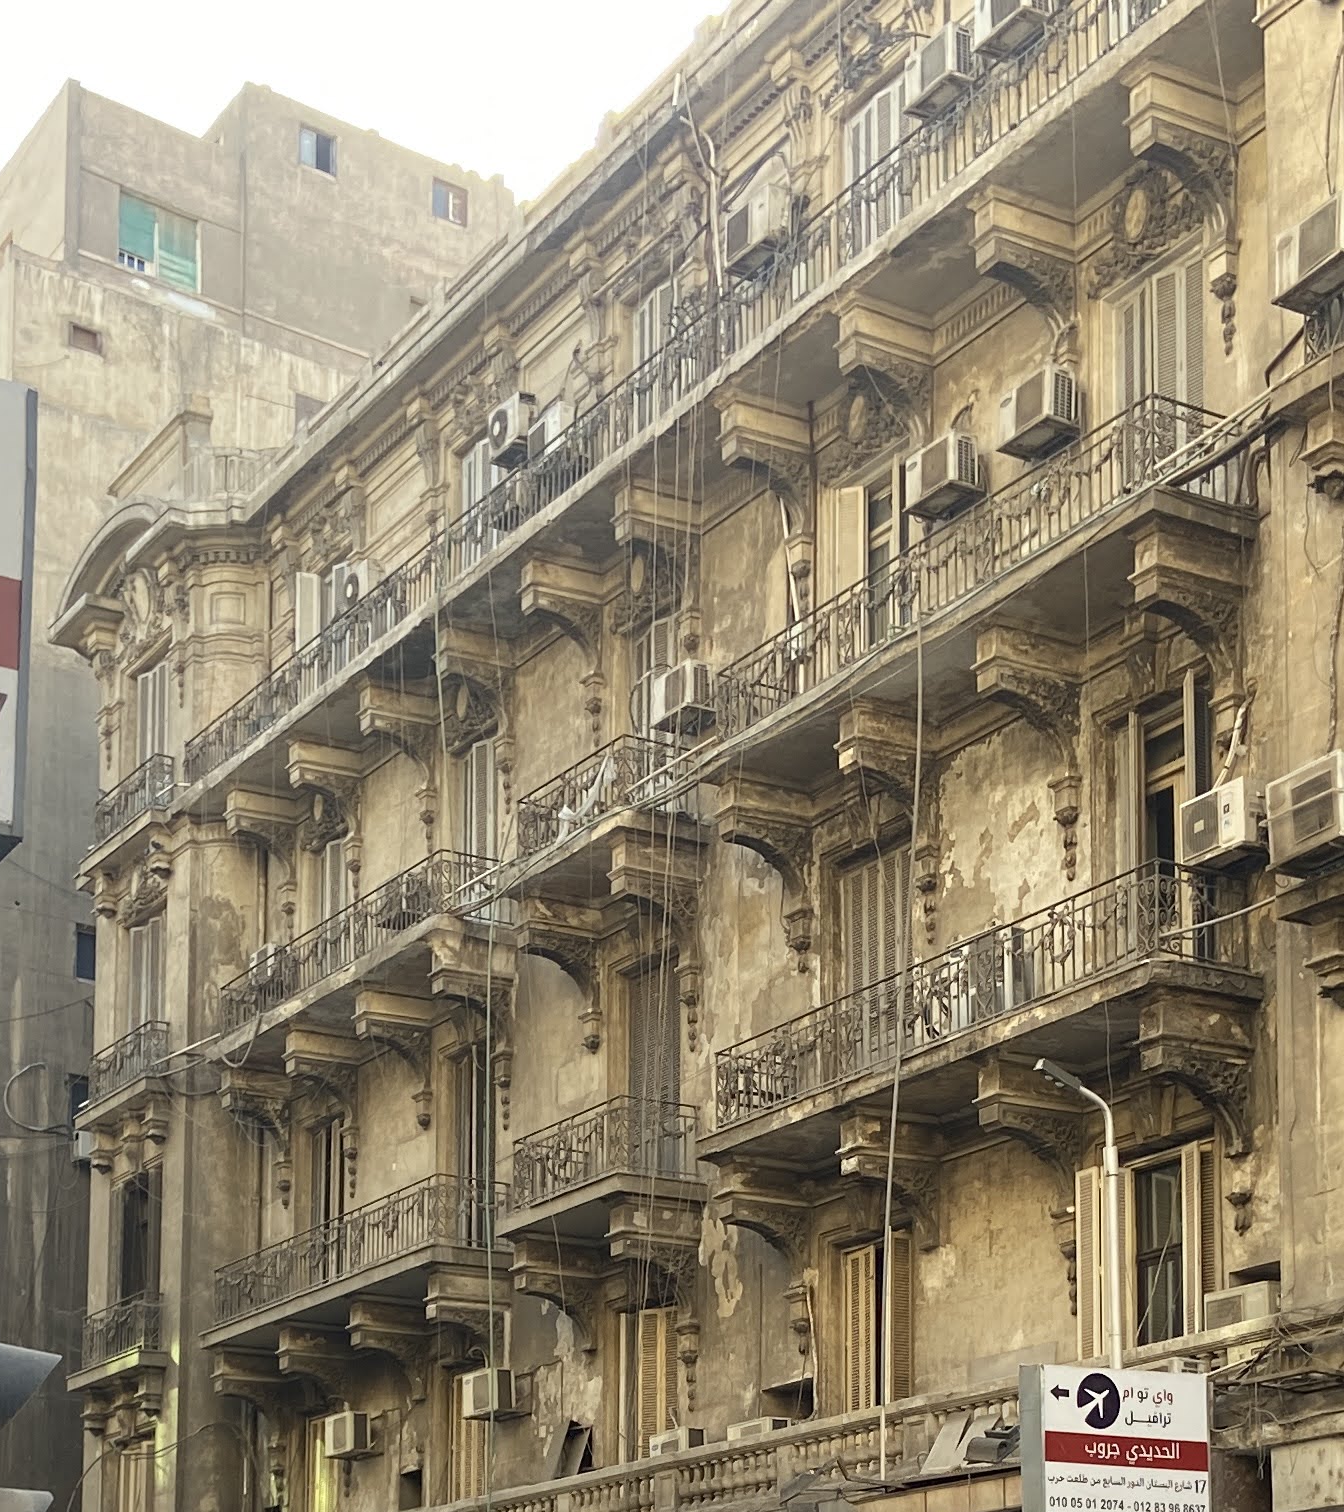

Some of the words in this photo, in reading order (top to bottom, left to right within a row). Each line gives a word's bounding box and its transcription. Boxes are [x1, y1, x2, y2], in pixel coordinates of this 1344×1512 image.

[1122, 1386, 1133, 1402] ام
[1137, 1387, 1149, 1404] تو
[1152, 1389, 1173, 1408] واي
[1124, 1410, 1171, 1428] ترافيل
[1084, 1441, 1120, 1459] جروب
[1125, 1442, 1180, 1465] الحديدي
[1194, 1479, 1207, 1494] 17
[1049, 1495, 1067, 1508] 010
[1070, 1497, 1083, 1508] 05
[1085, 1498, 1096, 1509] 01
[1100, 1499, 1124, 1511] 2074
[1133, 1501, 1151, 1512] 012
[1154, 1502, 1166, 1512] 83
